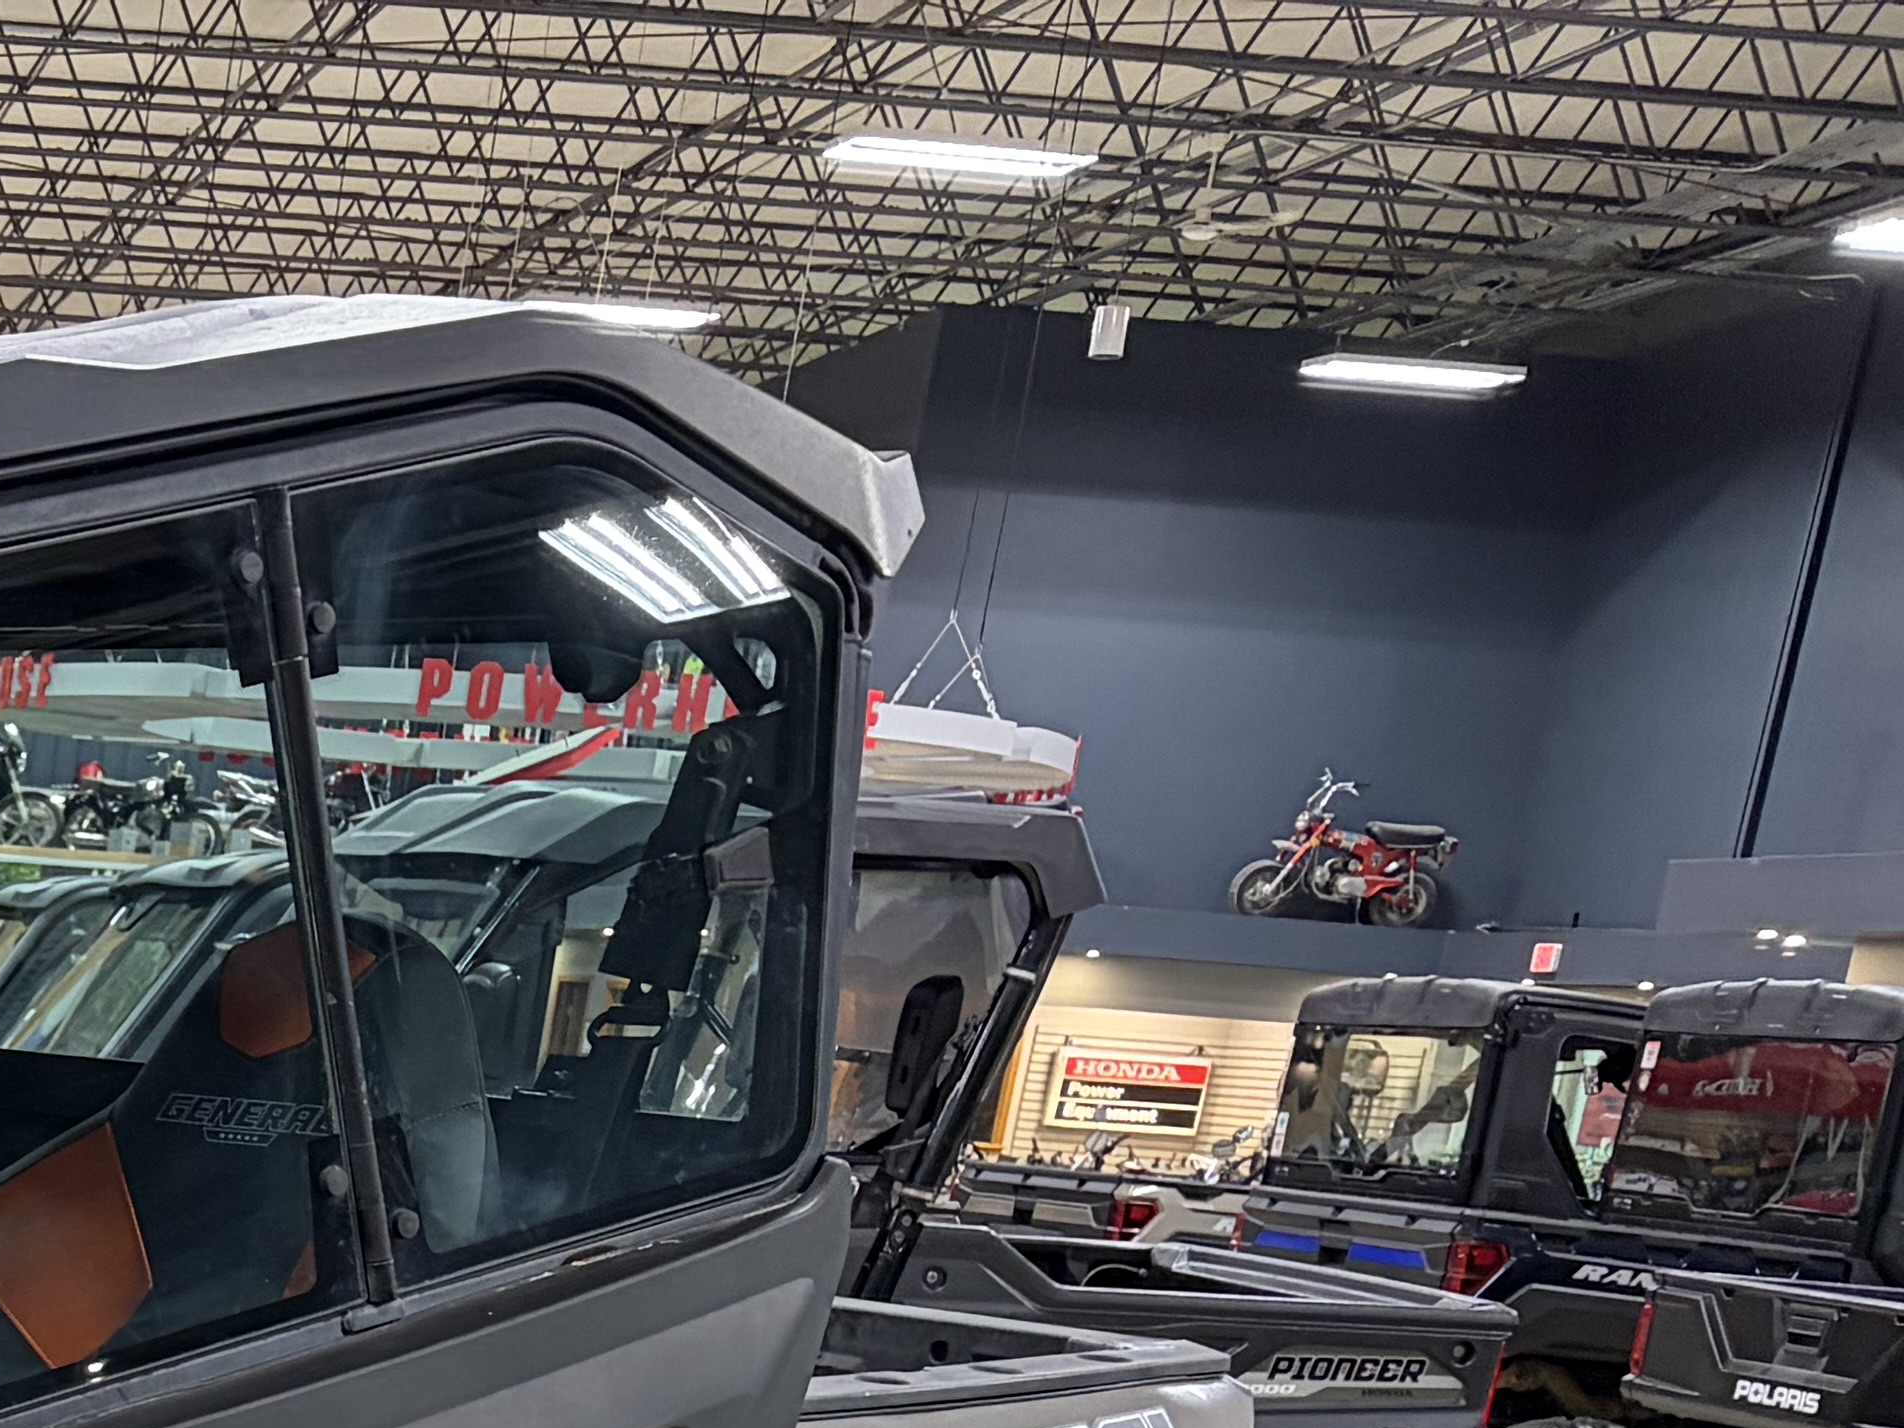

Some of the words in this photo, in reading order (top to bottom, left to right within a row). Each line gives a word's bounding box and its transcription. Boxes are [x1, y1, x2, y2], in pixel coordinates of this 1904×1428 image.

[1073, 1059, 1181, 1082] HONDA
[1067, 1081, 1125, 1100] Power
[1267, 1354, 1429, 1384] PIONEER
[1733, 1379, 1822, 1415] POLARIS
